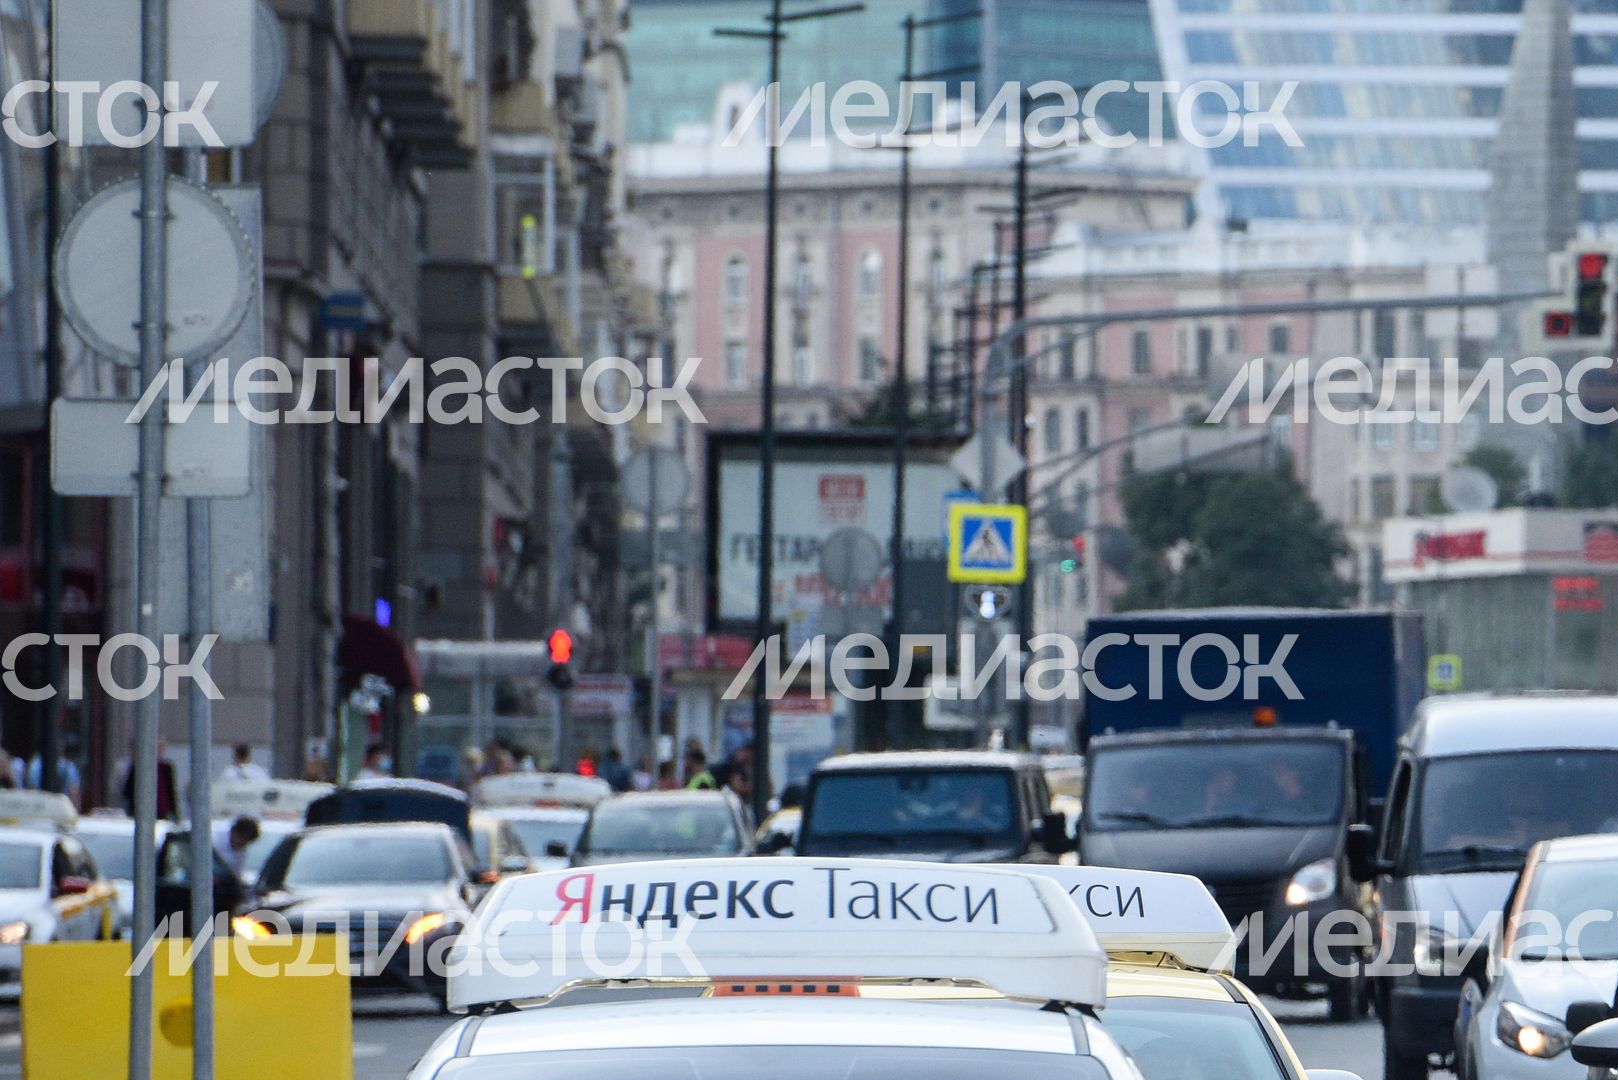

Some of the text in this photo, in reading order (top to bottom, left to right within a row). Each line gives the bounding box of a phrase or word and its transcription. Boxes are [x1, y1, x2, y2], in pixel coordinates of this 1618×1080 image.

[551, 867, 1000, 929] Яндекс Такси
[1069, 884, 1145, 918] си
